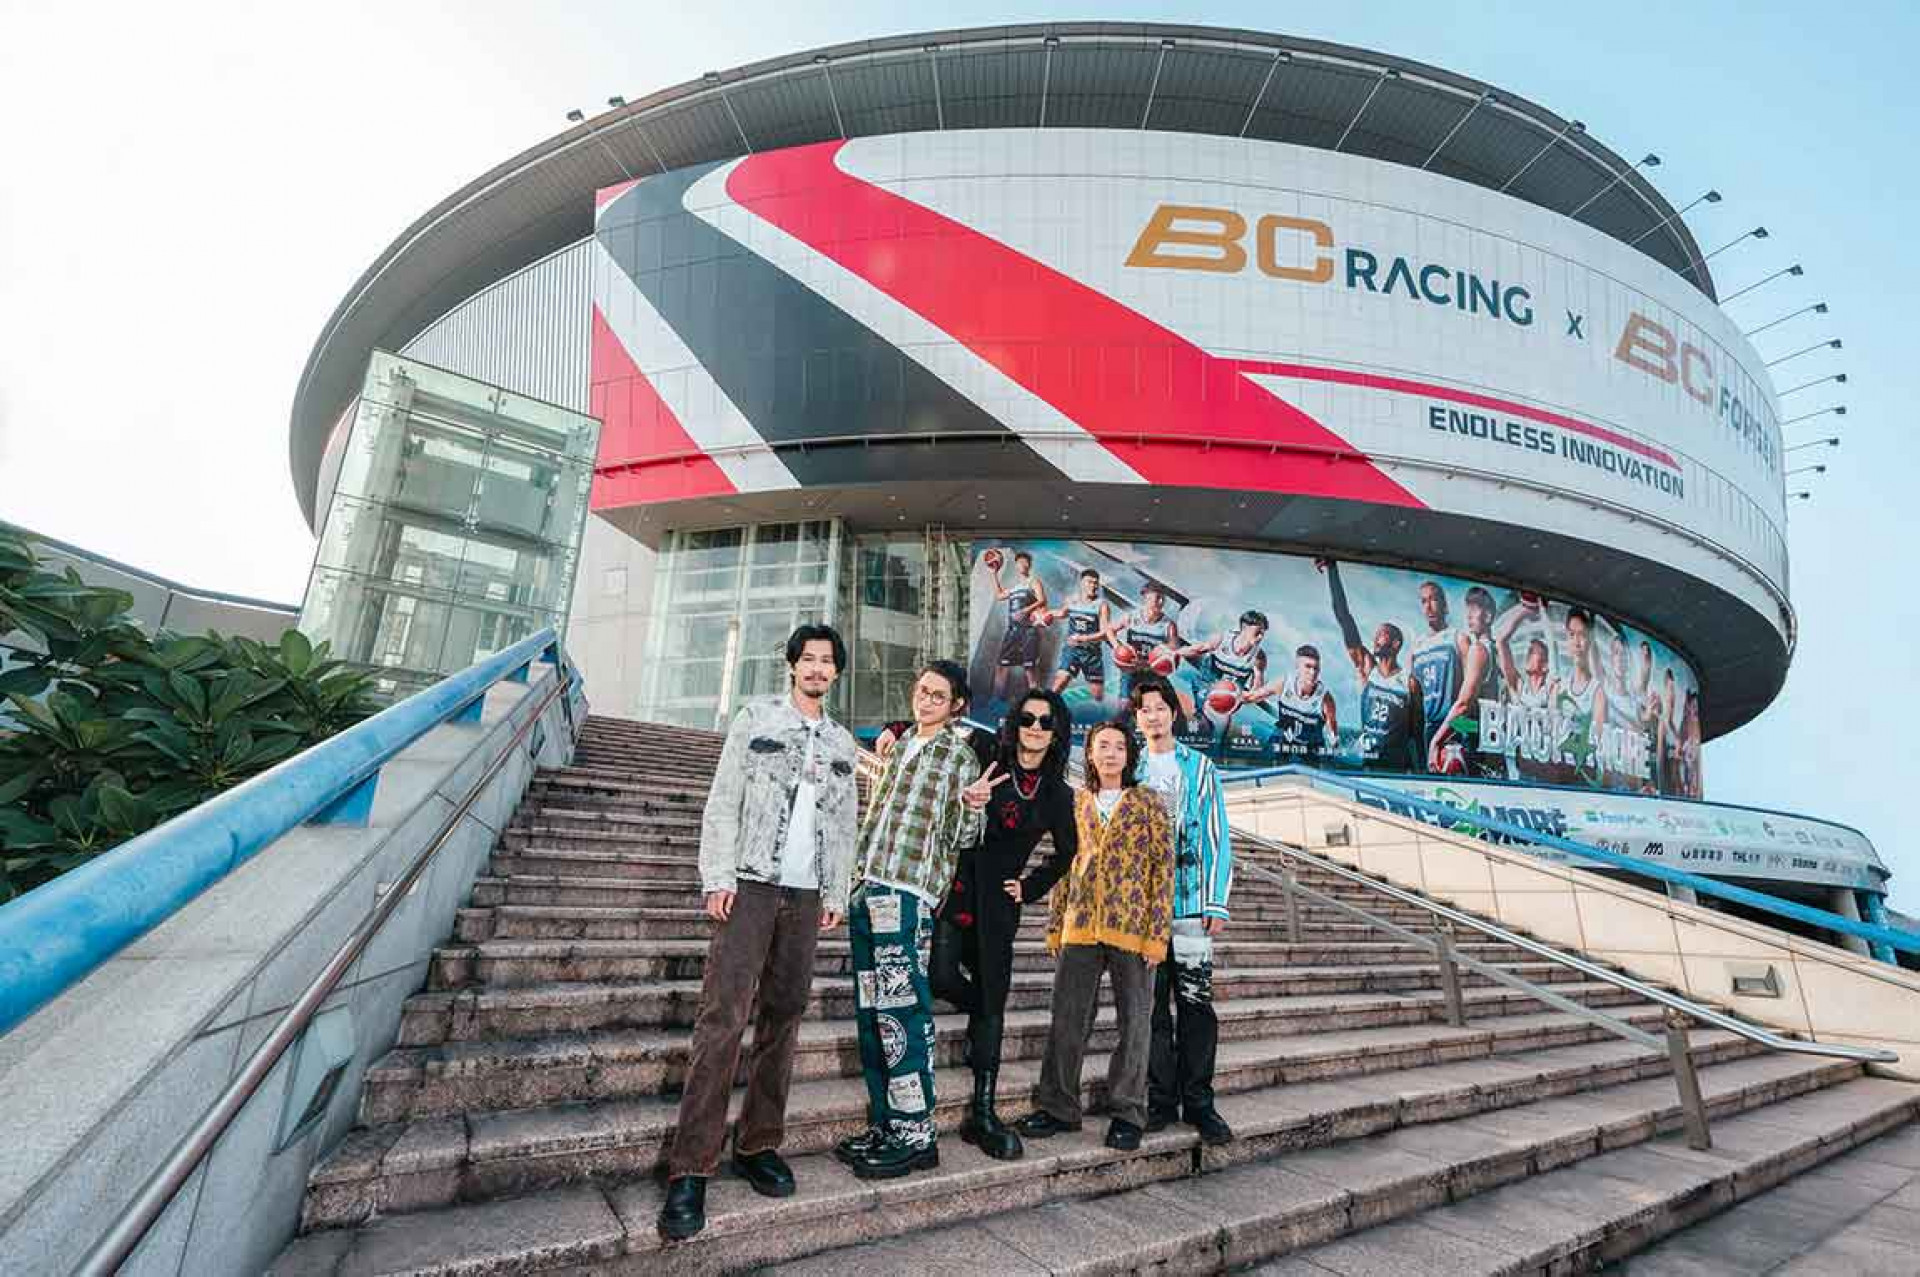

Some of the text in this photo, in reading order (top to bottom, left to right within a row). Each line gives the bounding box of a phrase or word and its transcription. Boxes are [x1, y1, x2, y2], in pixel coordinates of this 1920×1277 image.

[1124, 204, 1335, 284] BC
[1346, 248, 1534, 326] RACING
[1615, 312, 1714, 405] BC
[1429, 406, 1685, 499] ENDLESS INNOVATION
